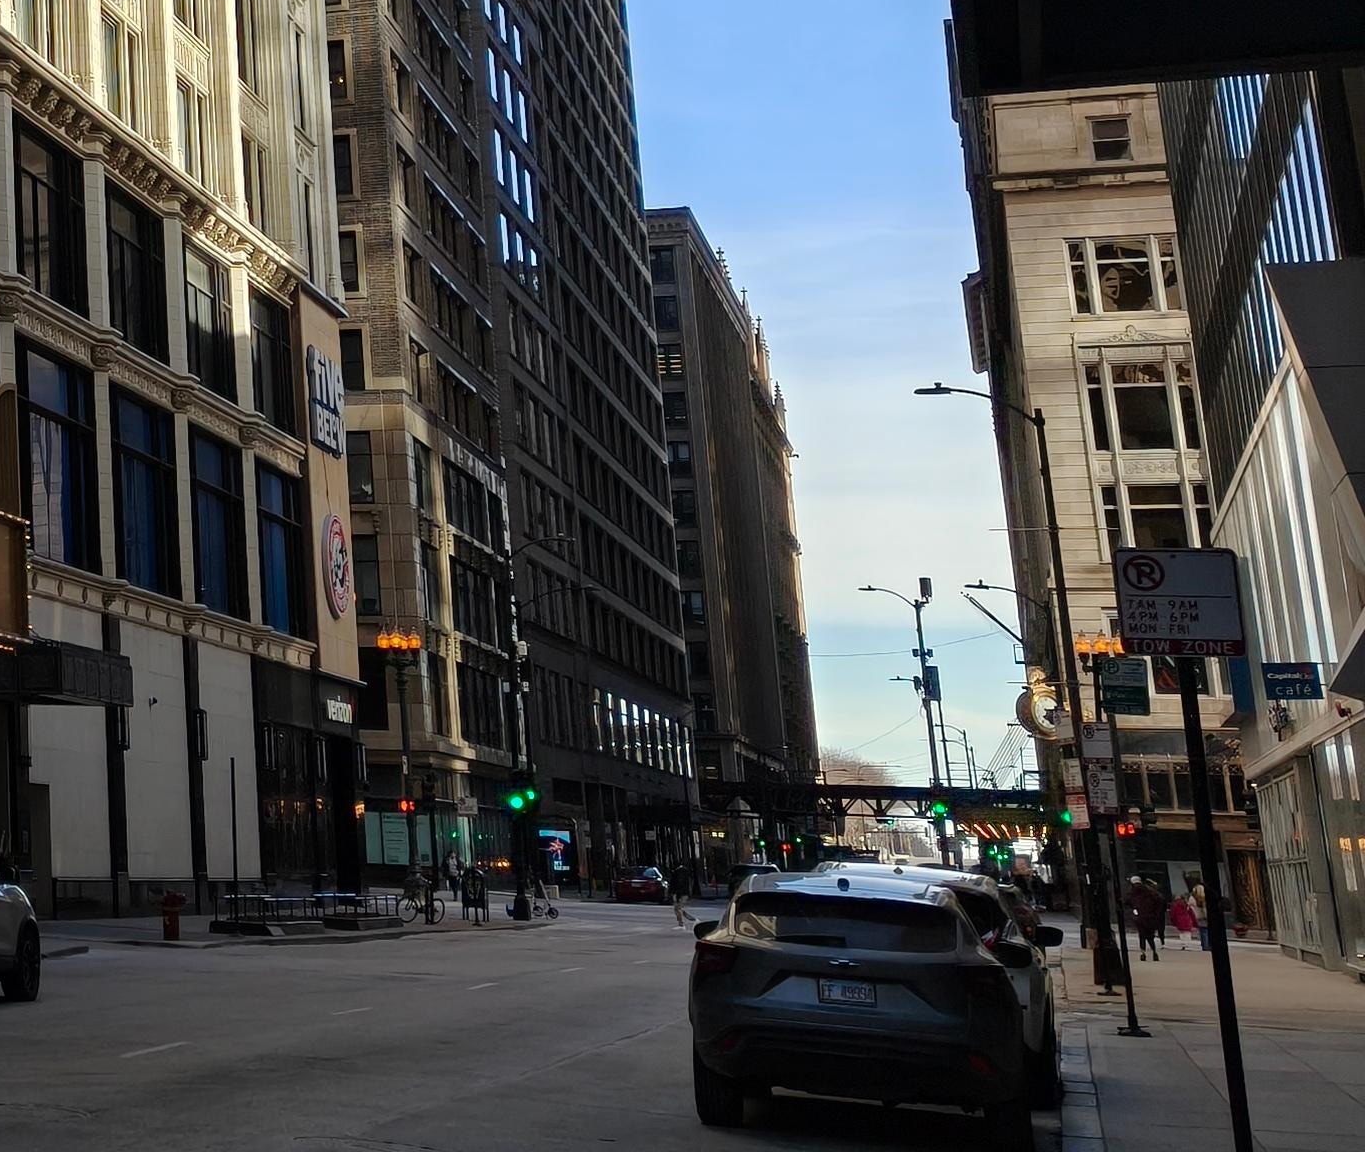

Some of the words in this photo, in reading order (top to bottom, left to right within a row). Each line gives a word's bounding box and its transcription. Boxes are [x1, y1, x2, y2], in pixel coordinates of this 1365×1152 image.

[1170, 613, 1200, 622] 6PM
[1133, 640, 1170, 653] TOW
[1182, 640, 1234, 654] ZONE
[1275, 683, 1312, 696] café
[326, 696, 353, 724] verizon
